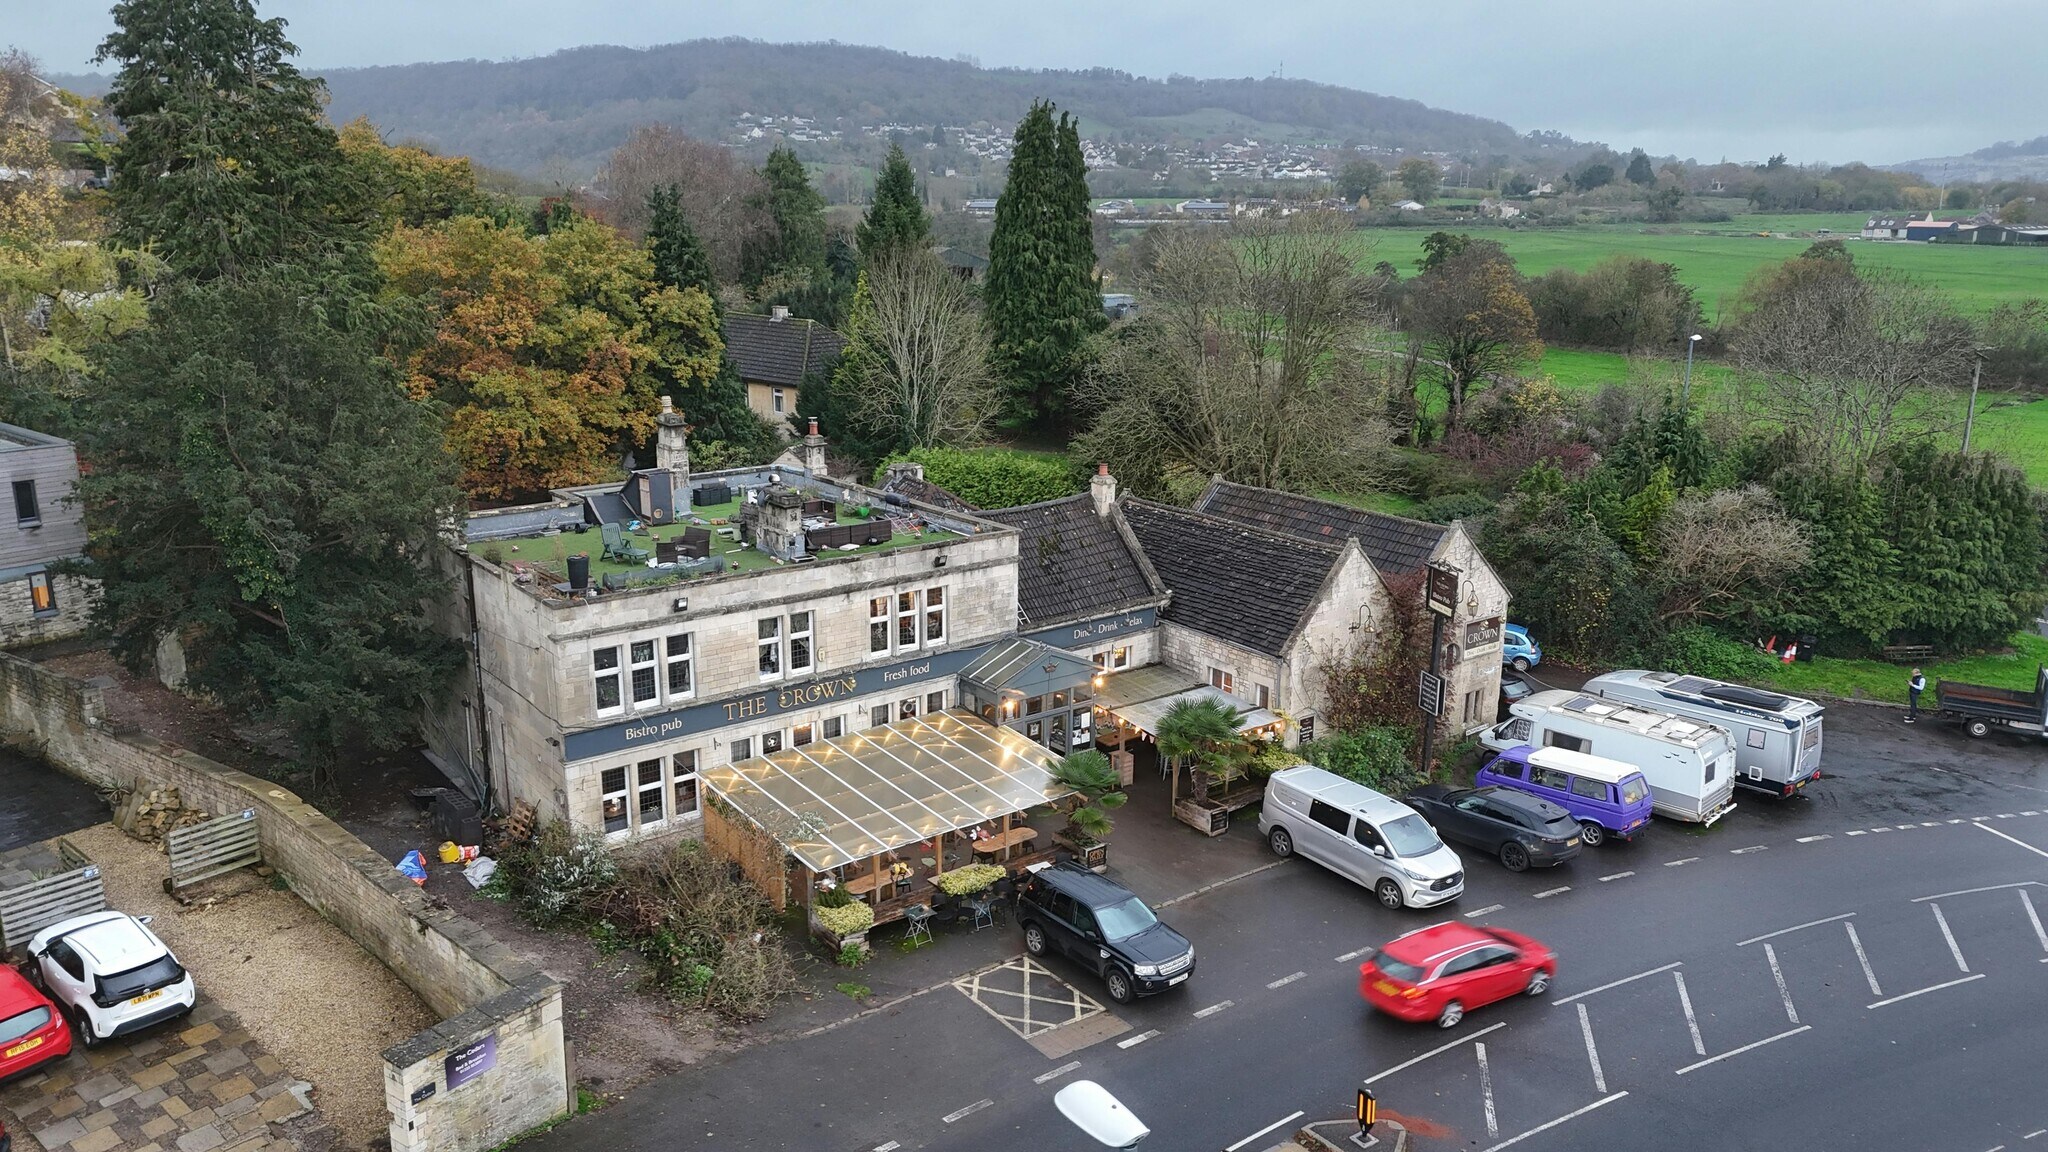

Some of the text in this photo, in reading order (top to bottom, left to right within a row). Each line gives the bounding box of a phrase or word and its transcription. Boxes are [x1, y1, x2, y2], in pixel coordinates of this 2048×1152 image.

[1098, 620, 1118, 633] Drink
[1124, 616, 1143, 628] elax
[1467, 627, 1498, 644] CROWN
[625, 662, 930, 740] Bistro pub THE CROWN Fresh food
[1735, 709, 1766, 719] Hobby
[455, 1043, 485, 1061] The Cedars
